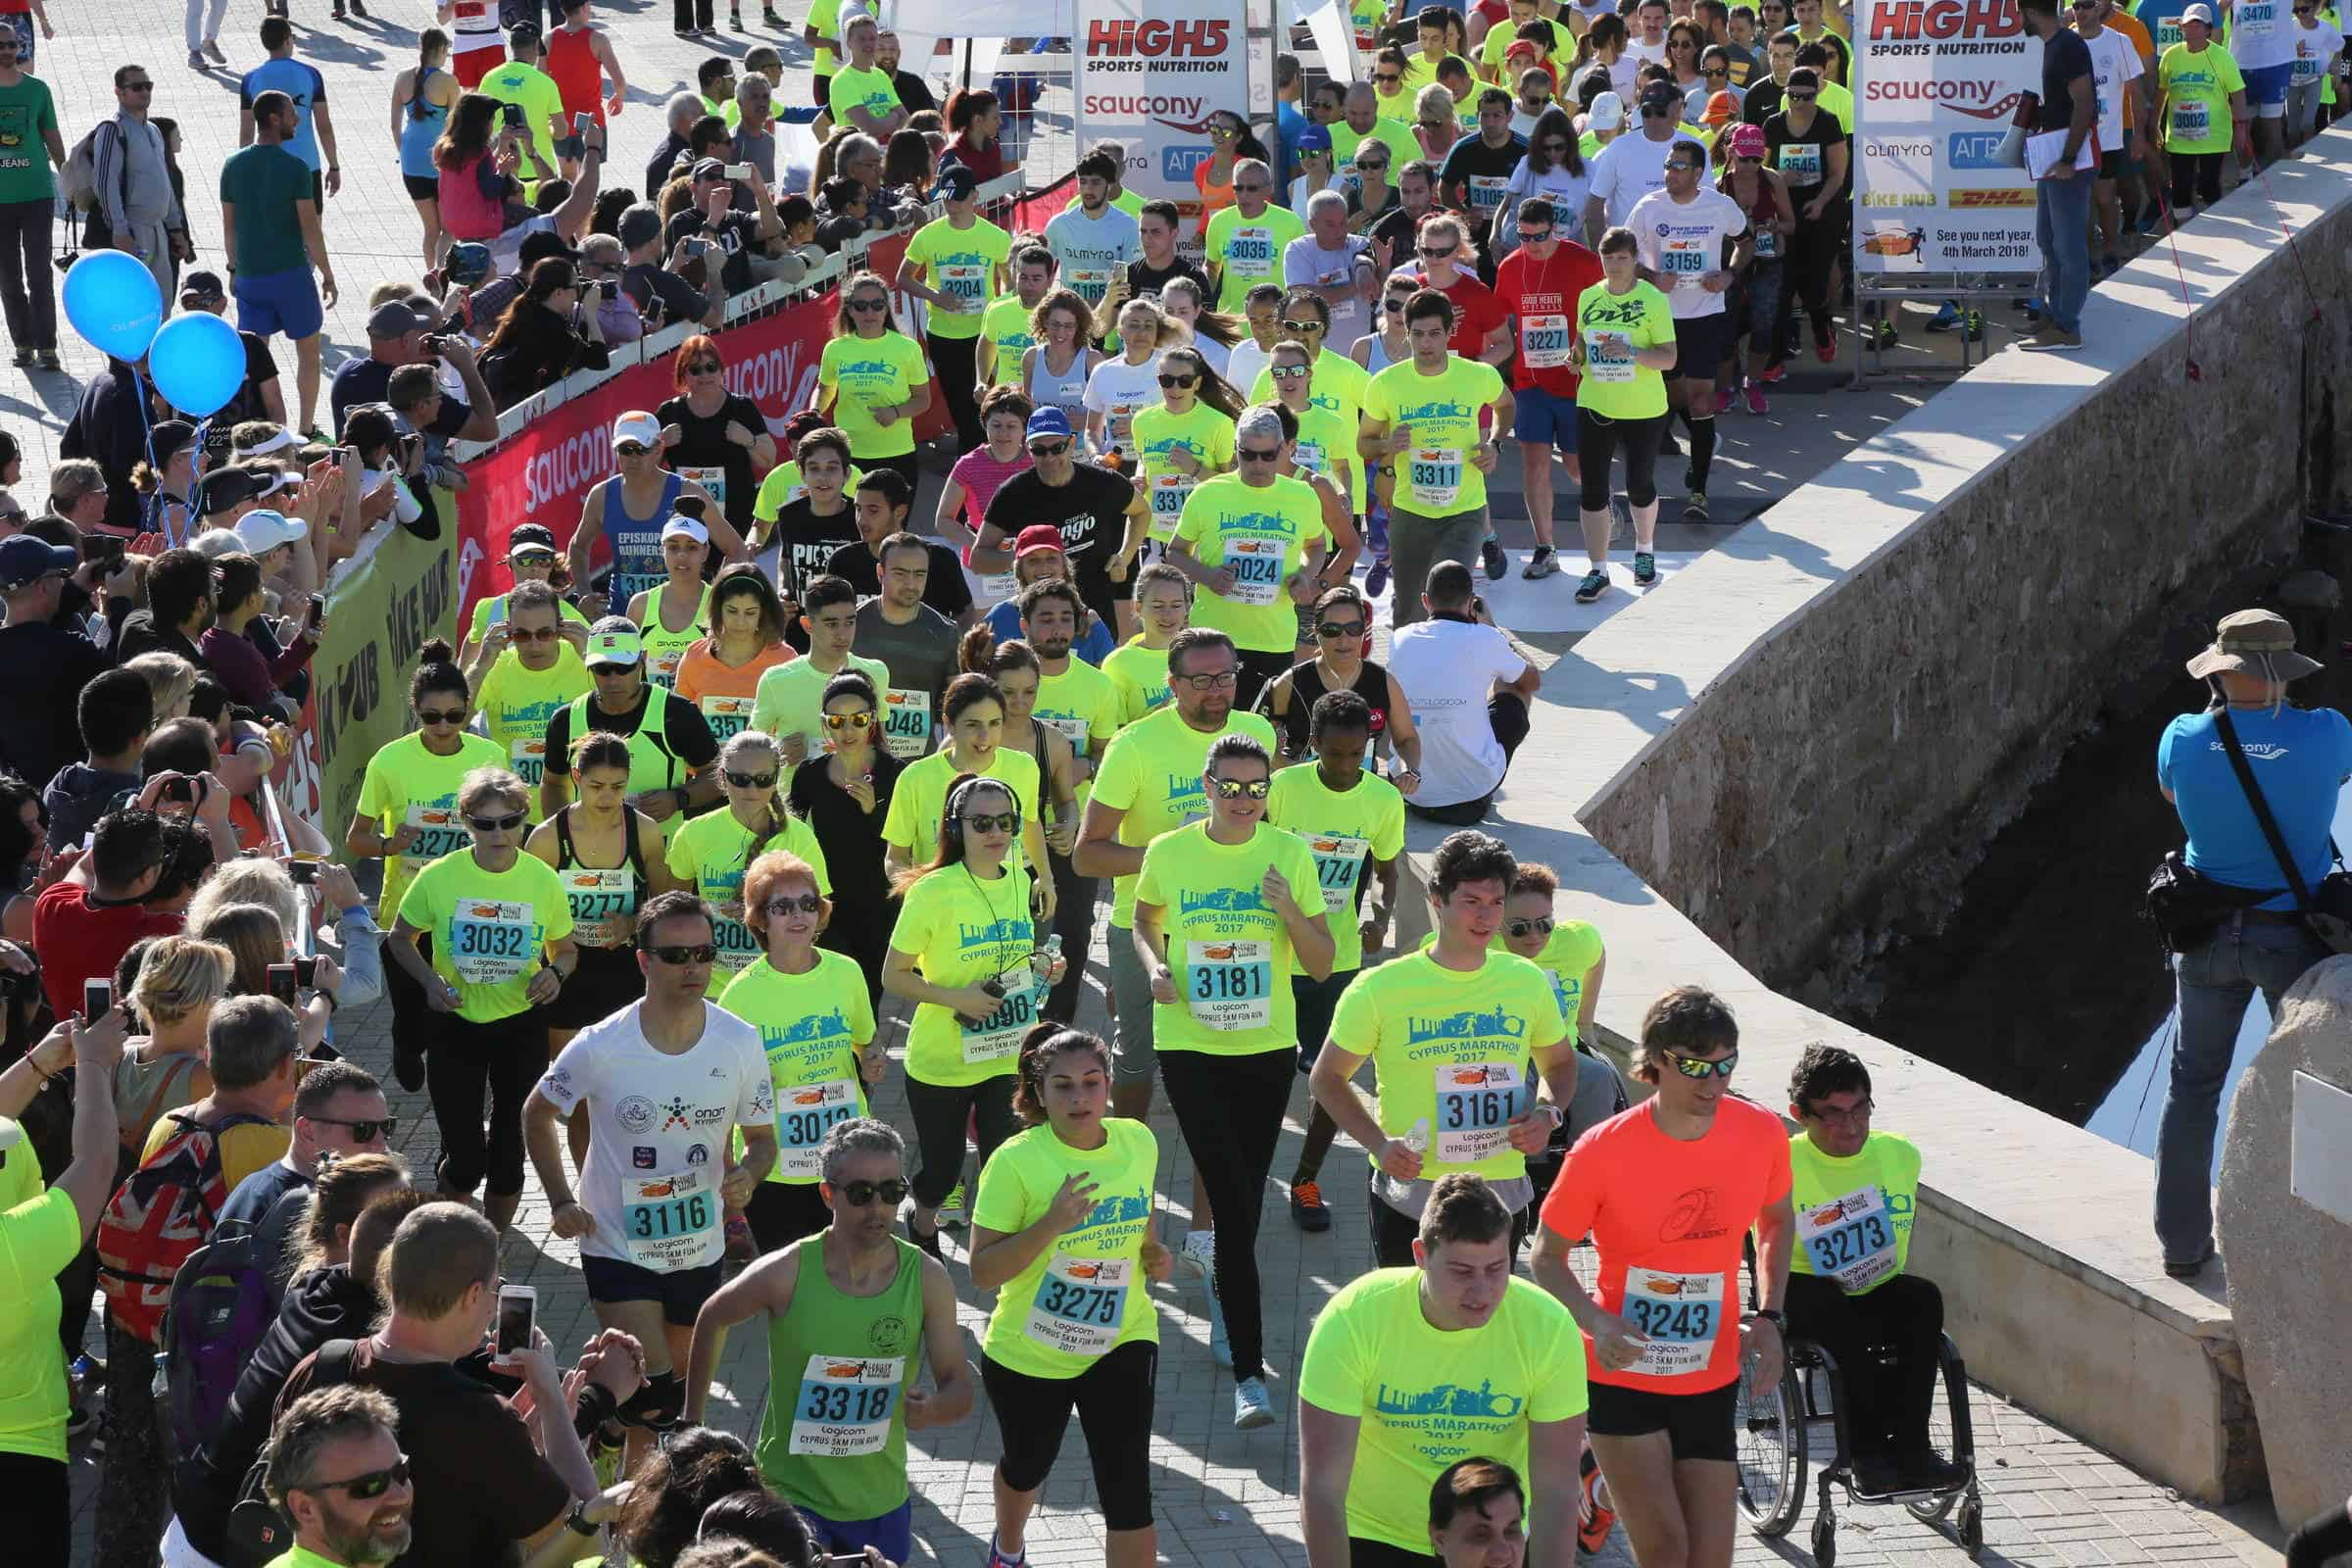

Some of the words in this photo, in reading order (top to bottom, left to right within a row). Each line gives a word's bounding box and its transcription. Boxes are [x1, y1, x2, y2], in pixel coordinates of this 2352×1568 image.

[2244, 6, 2272, 21] 3470
[2160, 28, 2183, 43] 315
[1870, 43, 1931, 57] SPORTS
[1936, 41, 2026, 56] NUTRITION
[1087, 61, 1143, 73] SPORTS
[1148, 61, 1229, 73] NUTRITION
[1866, 79, 1996, 104] saucony
[1085, 95, 1203, 119] saucony
[0, 158, 30, 168] JEANS
[1862, 192, 1898, 208] BIKE
[1903, 192, 1936, 207] HUB
[1960, 191, 2025, 205] DHL
[1936, 229, 1958, 242] See
[1961, 232, 1980, 246] you
[1983, 230, 2005, 242] next
[1232, 240, 1267, 260] 3035
[1942, 246, 1959, 258] 4th
[1962, 246, 1996, 258] March
[1998, 245, 2029, 258] 2018!
[1666, 252, 1702, 270] 3159
[945, 279, 981, 298] 3204
[1527, 330, 1563, 350] 3227
[1415, 464, 1455, 486] 3311
[1156, 490, 1188, 513] 331
[618, 532, 662, 544] EPISKOP
[618, 545, 665, 557] RUNNERS
[885, 710, 923, 735] 048
[518, 760, 544, 785] 30
[1167, 798, 1207, 814] CYPRUS
[1316, 858, 1353, 886] 174
[567, 893, 626, 920] 3277
[1182, 912, 1217, 929] CYPRUS
[1220, 912, 1277, 927] MARATHON
[1214, 923, 1244, 933] 2017
[462, 923, 523, 956] 3032
[714, 920, 757, 951] 300
[961, 946, 999, 962] CYPRUS
[993, 953, 1019, 964] 2017
[473, 958, 508, 968] Logicom
[1197, 964, 1260, 999] 3181
[1212, 1003, 1250, 1012] Logicom
[1223, 1021, 1239, 1030] 2017
[984, 1031, 1019, 1043] Logicom
[1408, 1043, 1457, 1060] CYPRUS
[1459, 1040, 1521, 1053] MARATHON
[1454, 1052, 1486, 1063] 2017
[804, 1052, 834, 1065] 2017
[798, 1065, 838, 1082] Logicom
[1446, 1091, 1514, 1128] 3161
[1462, 1130, 1499, 1142] Logicom
[1446, 1143, 1472, 1153] CYPRUS
[1473, 1143, 1488, 1152] 5KM
[1473, 1152, 1488, 1161] 2017
[634, 1195, 707, 1237] 3116
[653, 1237, 695, 1250] Logicom
[1057, 1229, 1103, 1250] CYPRUS
[1097, 1237, 1127, 1250] 2017
[1814, 1215, 1886, 1270] 3273
[637, 1250, 665, 1261] CYPRUS
[682, 1246, 697, 1256] FUN
[667, 1257, 684, 1267] 2017
[1841, 1257, 1879, 1278] Logicom
[1046, 1281, 1119, 1324] 3275
[1634, 1298, 1710, 1339] 3243
[1033, 1321, 1061, 1340] CYPRUS
[1054, 1320, 1095, 1336] Logicom
[1057, 1343, 1076, 1353] 2017
[1644, 1343, 1690, 1354] Logicom
[1655, 1355, 1673, 1365] 5KM
[1674, 1355, 1689, 1365] FUN
[808, 1385, 890, 1421] 3318
[821, 1425, 866, 1436] Logicom
[800, 1435, 830, 1446] CYPRUS
[831, 1438, 849, 1446] 5KM
[850, 1437, 864, 1446] FUN
